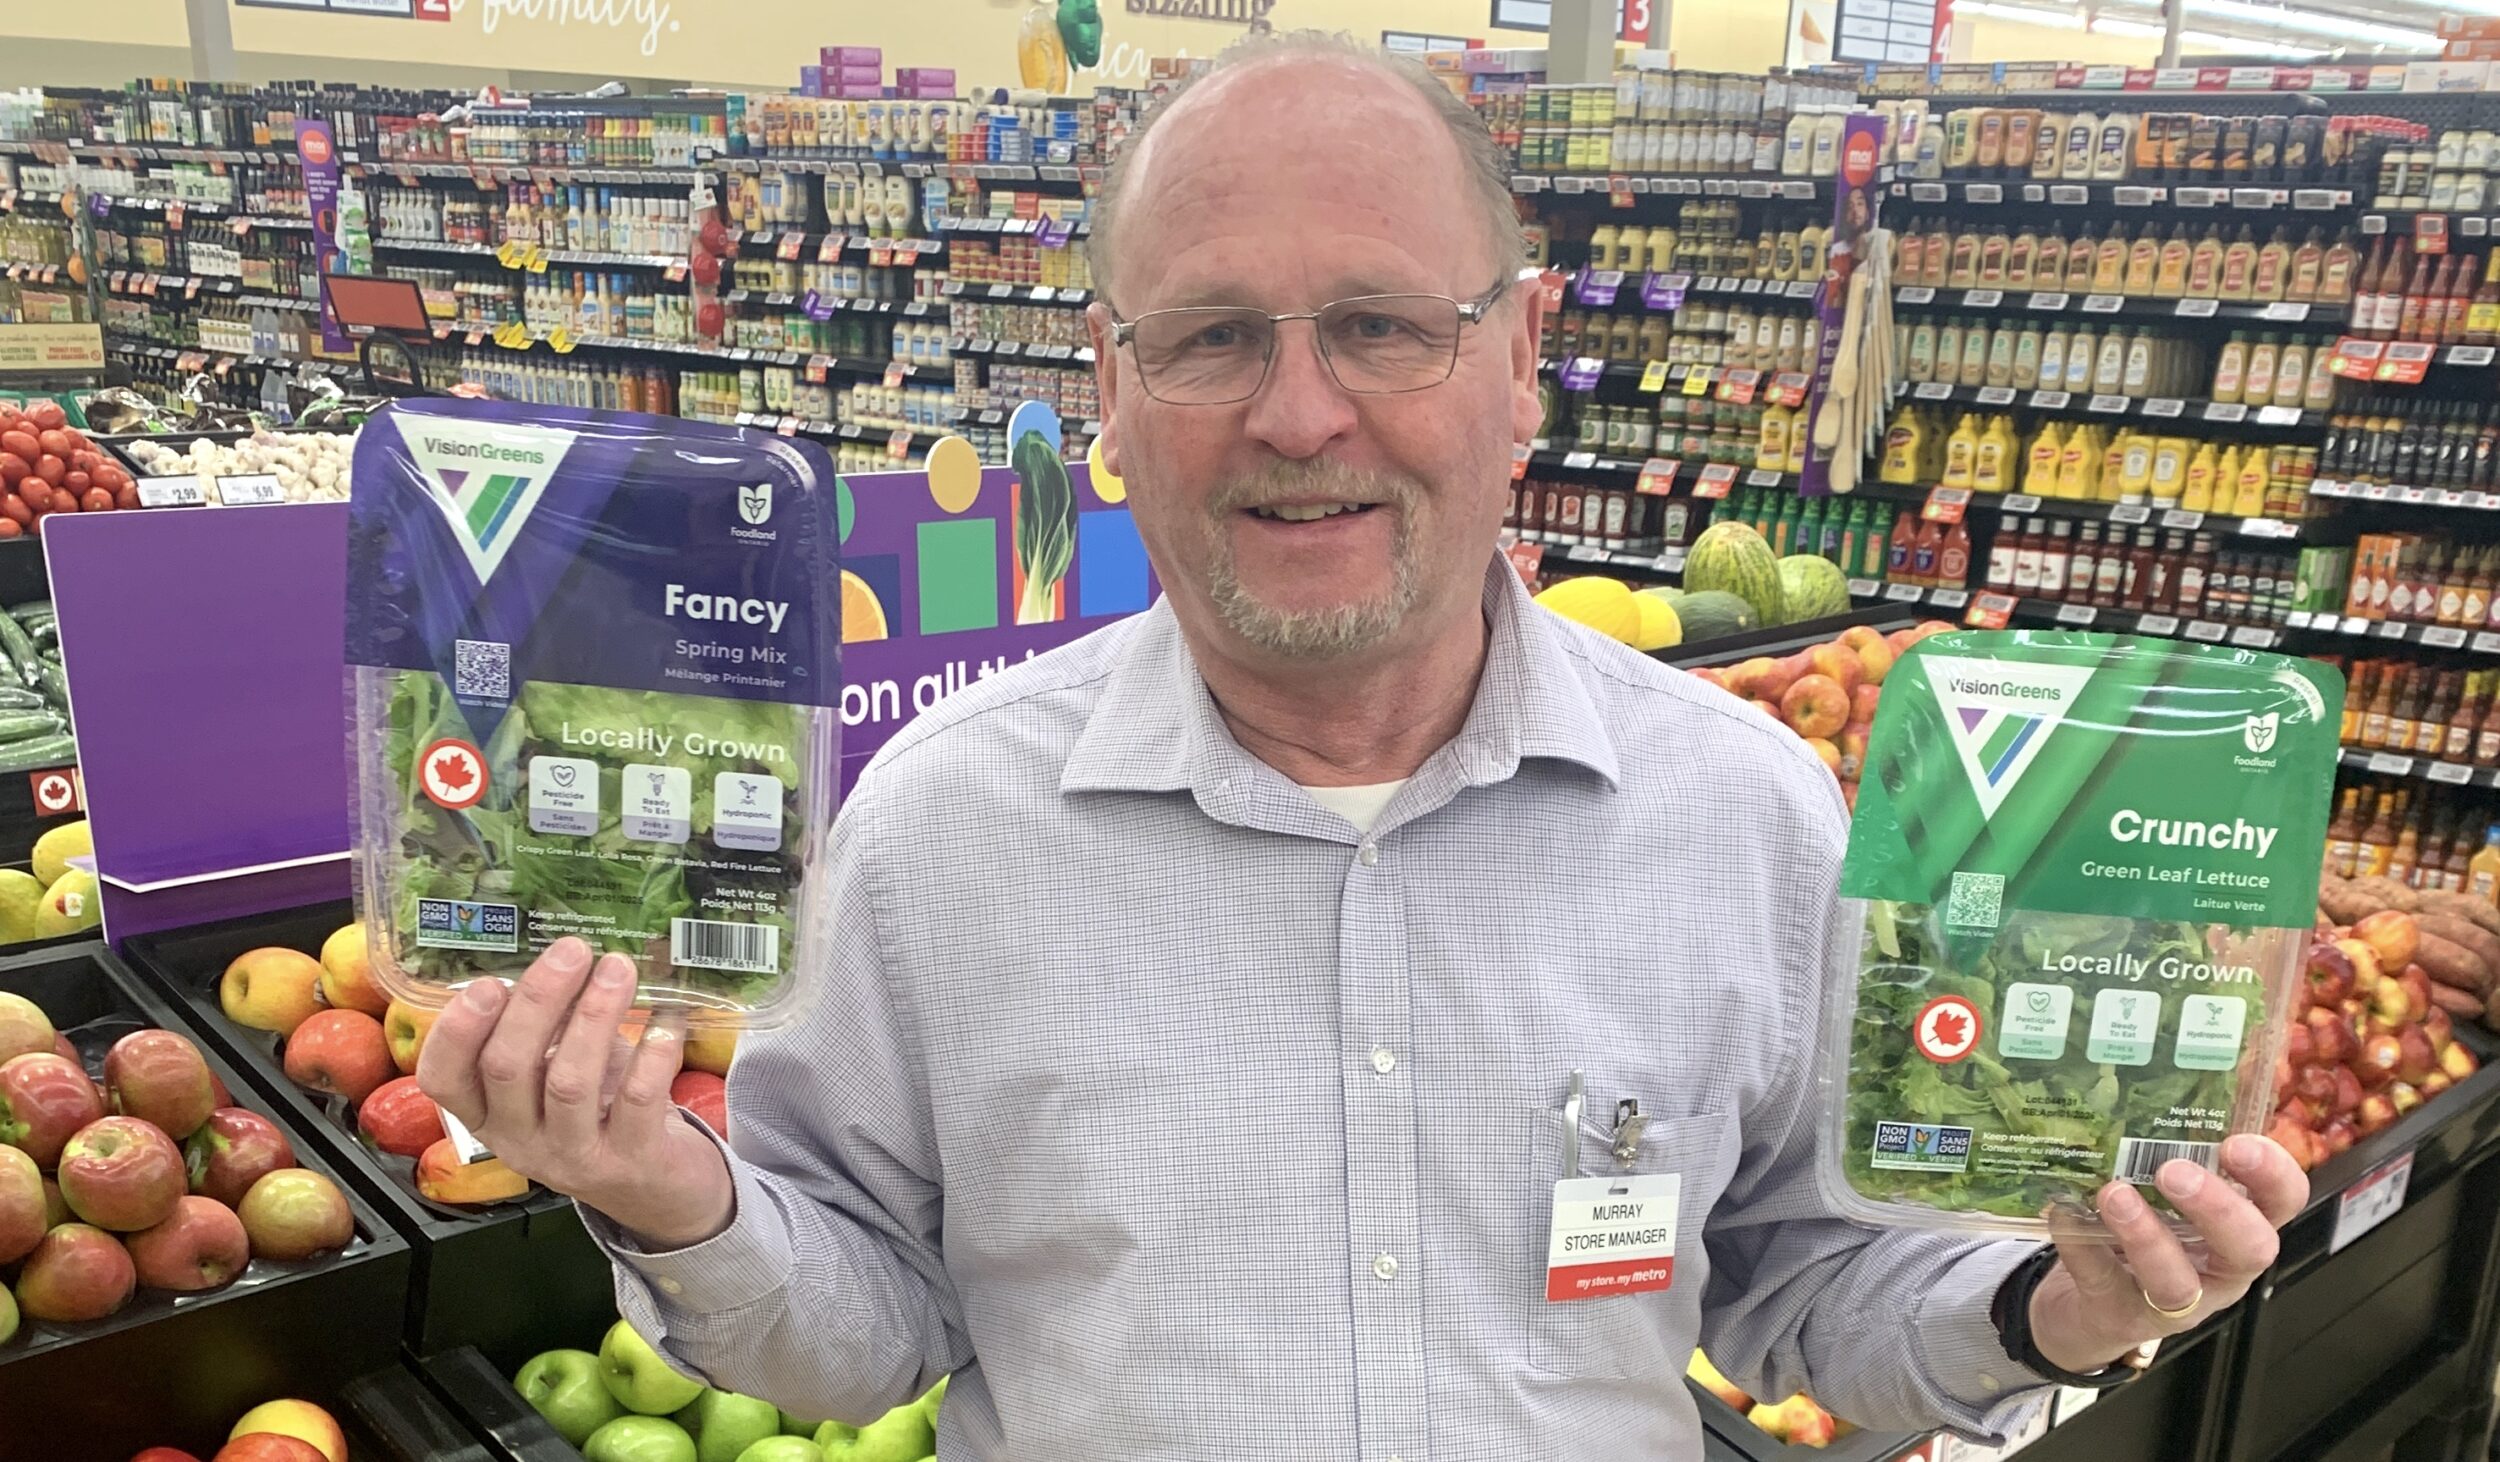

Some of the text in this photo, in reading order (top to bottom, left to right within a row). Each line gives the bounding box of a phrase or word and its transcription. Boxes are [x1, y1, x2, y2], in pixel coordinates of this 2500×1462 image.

[1631, 0, 1650, 31] 3
[1936, 23, 1952, 62] 4
[1848, 149, 1873, 163] moi
[424, 437, 544, 465] VisionGreens
[730, 526, 777, 540] Foodland
[665, 584, 789, 633] Fancy
[675, 640, 787, 664] Spring Mix
[723, 673, 786, 688] Printanier
[841, 680, 900, 726] on
[912, 661, 967, 714] all
[1949, 678, 2061, 701] VisionGreens
[562, 722, 785, 762] Locally Grown
[2234, 755, 2277, 768] Foodland
[542, 790, 585, 800] Pesticide
[553, 800, 573, 808] Free
[642, 798, 670, 808] Ready
[642, 806, 671, 816] To Eat
[722, 809, 772, 820] Hydroponic
[552, 814, 574, 822] Sans
[540, 821, 587, 831] Pesticides
[638, 829, 672, 839] Manger
[717, 831, 777, 843] Hydroponique
[2110, 809, 2279, 859] Crunchy
[516, 845, 545, 855] Crispy
[546, 847, 573, 856] Green
[711, 861, 728, 869] Red
[730, 862, 747, 871] Fire
[748, 864, 782, 873] Lettuce
[2081, 861, 2271, 888] Green Leaf Lettuce
[716, 888, 777, 901] Net Wt 4oz
[421, 902, 449, 912] NON
[700, 898, 776, 914] Poids Net 113g
[2193, 898, 2266, 912] Laitue Verte
[421, 911, 449, 921] GMO
[484, 914, 513, 924] SANS
[528, 910, 616, 924] Keep refrigerated
[484, 923, 513, 932] OGM
[528, 922, 579, 933] Conserver
[580, 926, 594, 934] au
[1948, 929, 1972, 937] Watch
[2042, 949, 2254, 984] Locally Grown
[2015, 1015, 2056, 1025] Pesticide
[2111, 1021, 2137, 1031] Ready
[2110, 1030, 2120, 1038] To
[2186, 1031, 2232, 1040] Hydroponic
[2022, 1038, 2043, 1046] Sans
[2178, 1052, 2233, 1062] Hydroponique
[2170, 1107, 2226, 1118] Net Wt 4oz
[2154, 1117, 2224, 1131] Poids Net 113g
[1882, 1126, 1908, 1135] NON
[1880, 1135, 1907, 1144] GMO
[1940, 1136, 1968, 1146] SANS
[1983, 1132, 2066, 1145] Keep refrigerated
[1879, 1143, 1905, 1152] Project
[1939, 1145, 1966, 1154] OGM
[1981, 1143, 2105, 1159] Conserver au réfrigérateur
[1877, 1152, 1917, 1161] VERIFIED
[1593, 1204, 1644, 1221] MURRAY
[1565, 1228, 1667, 1251] STORE MANAGER
[1576, 1268, 1667, 1290] my store. my metro
